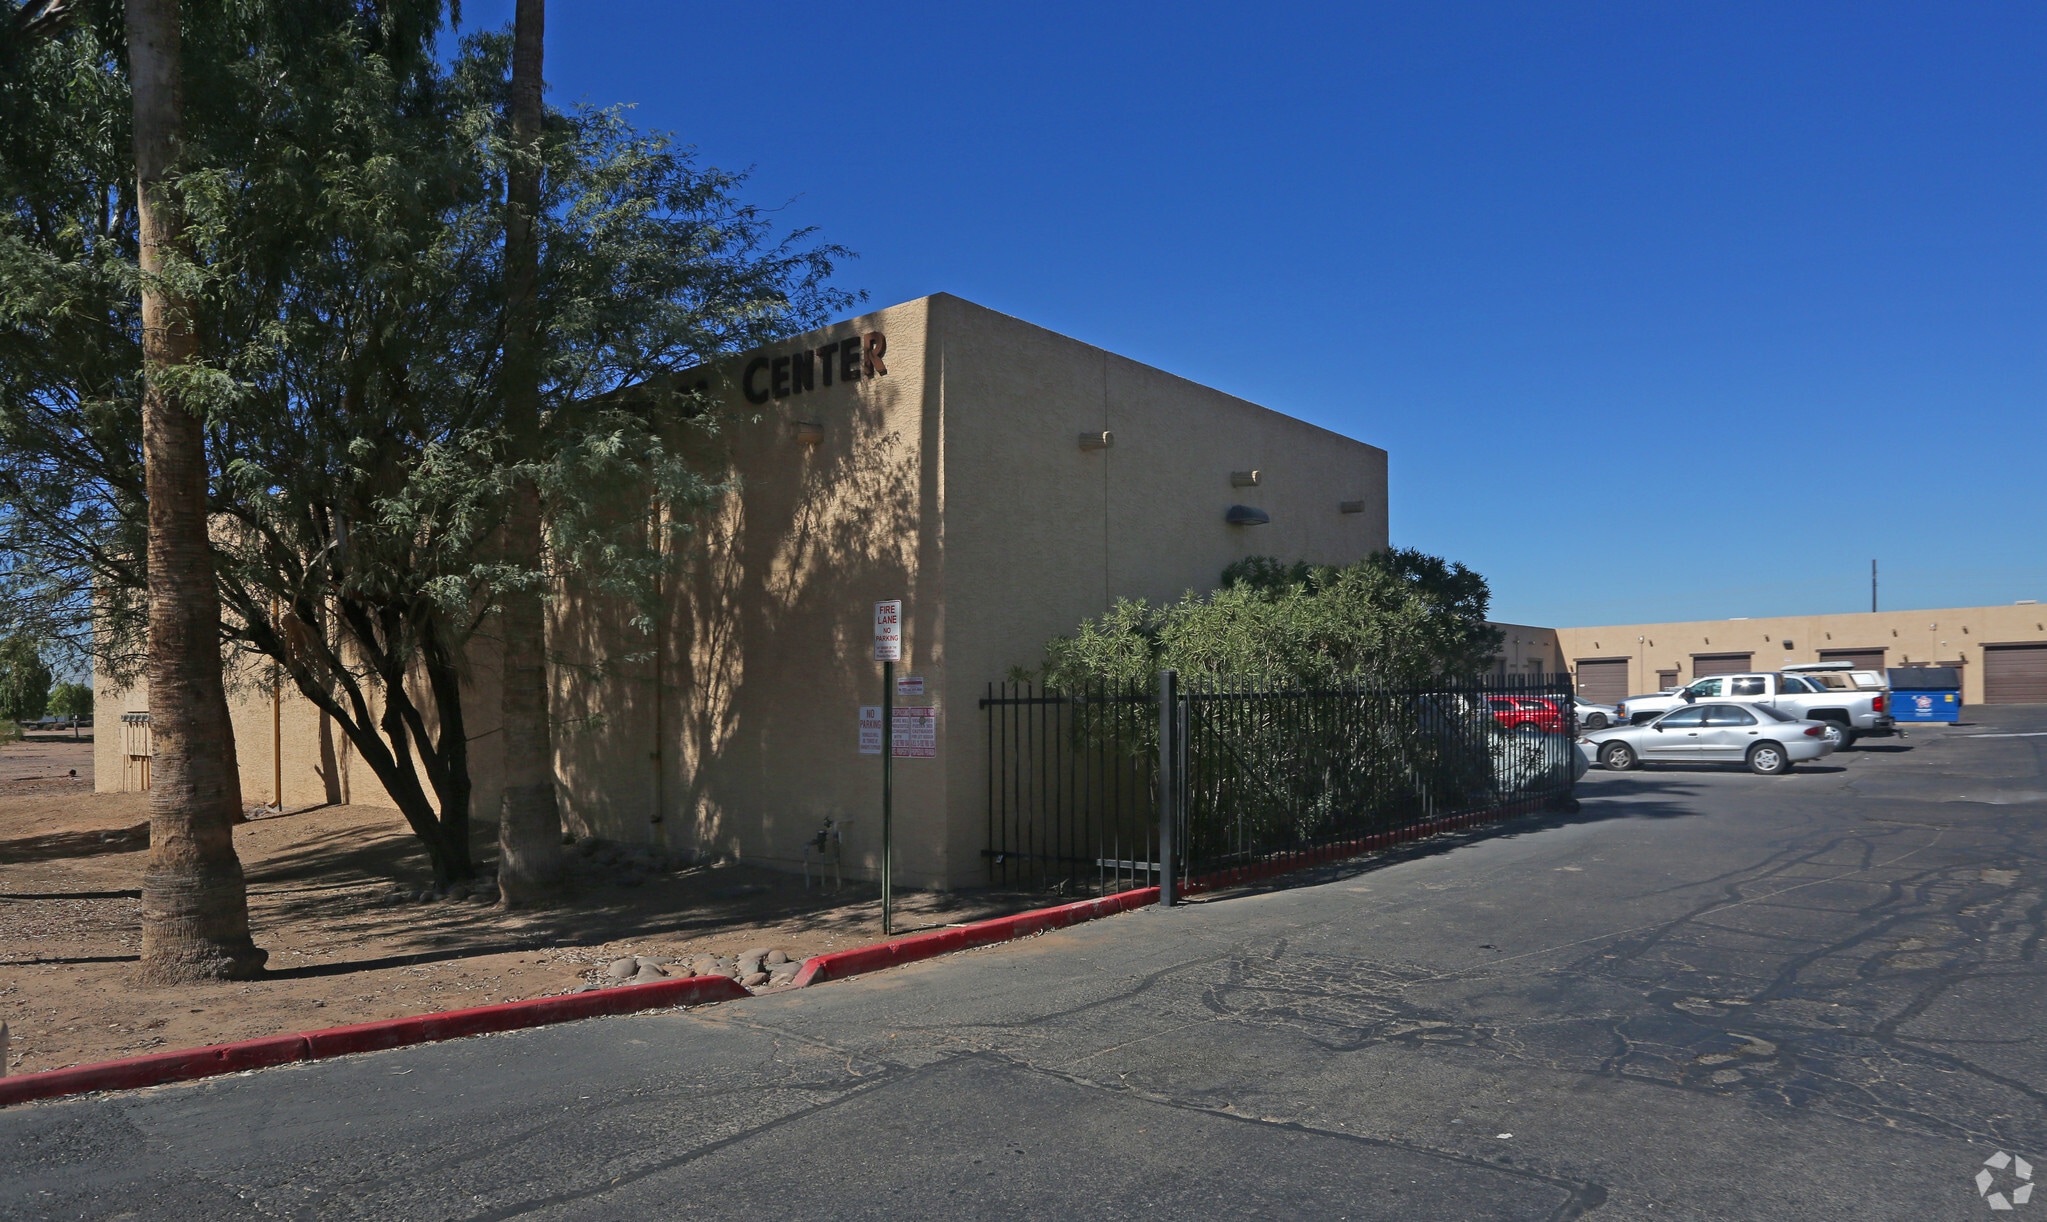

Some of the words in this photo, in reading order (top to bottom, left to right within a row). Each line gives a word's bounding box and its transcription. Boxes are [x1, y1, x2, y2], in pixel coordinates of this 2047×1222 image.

[742, 331, 888, 404] CENTER
[879, 605, 896, 614] FIRE
[877, 615, 897, 625] LANE
[866, 709, 875, 719] NO
[859, 720, 882, 729] PARKING
